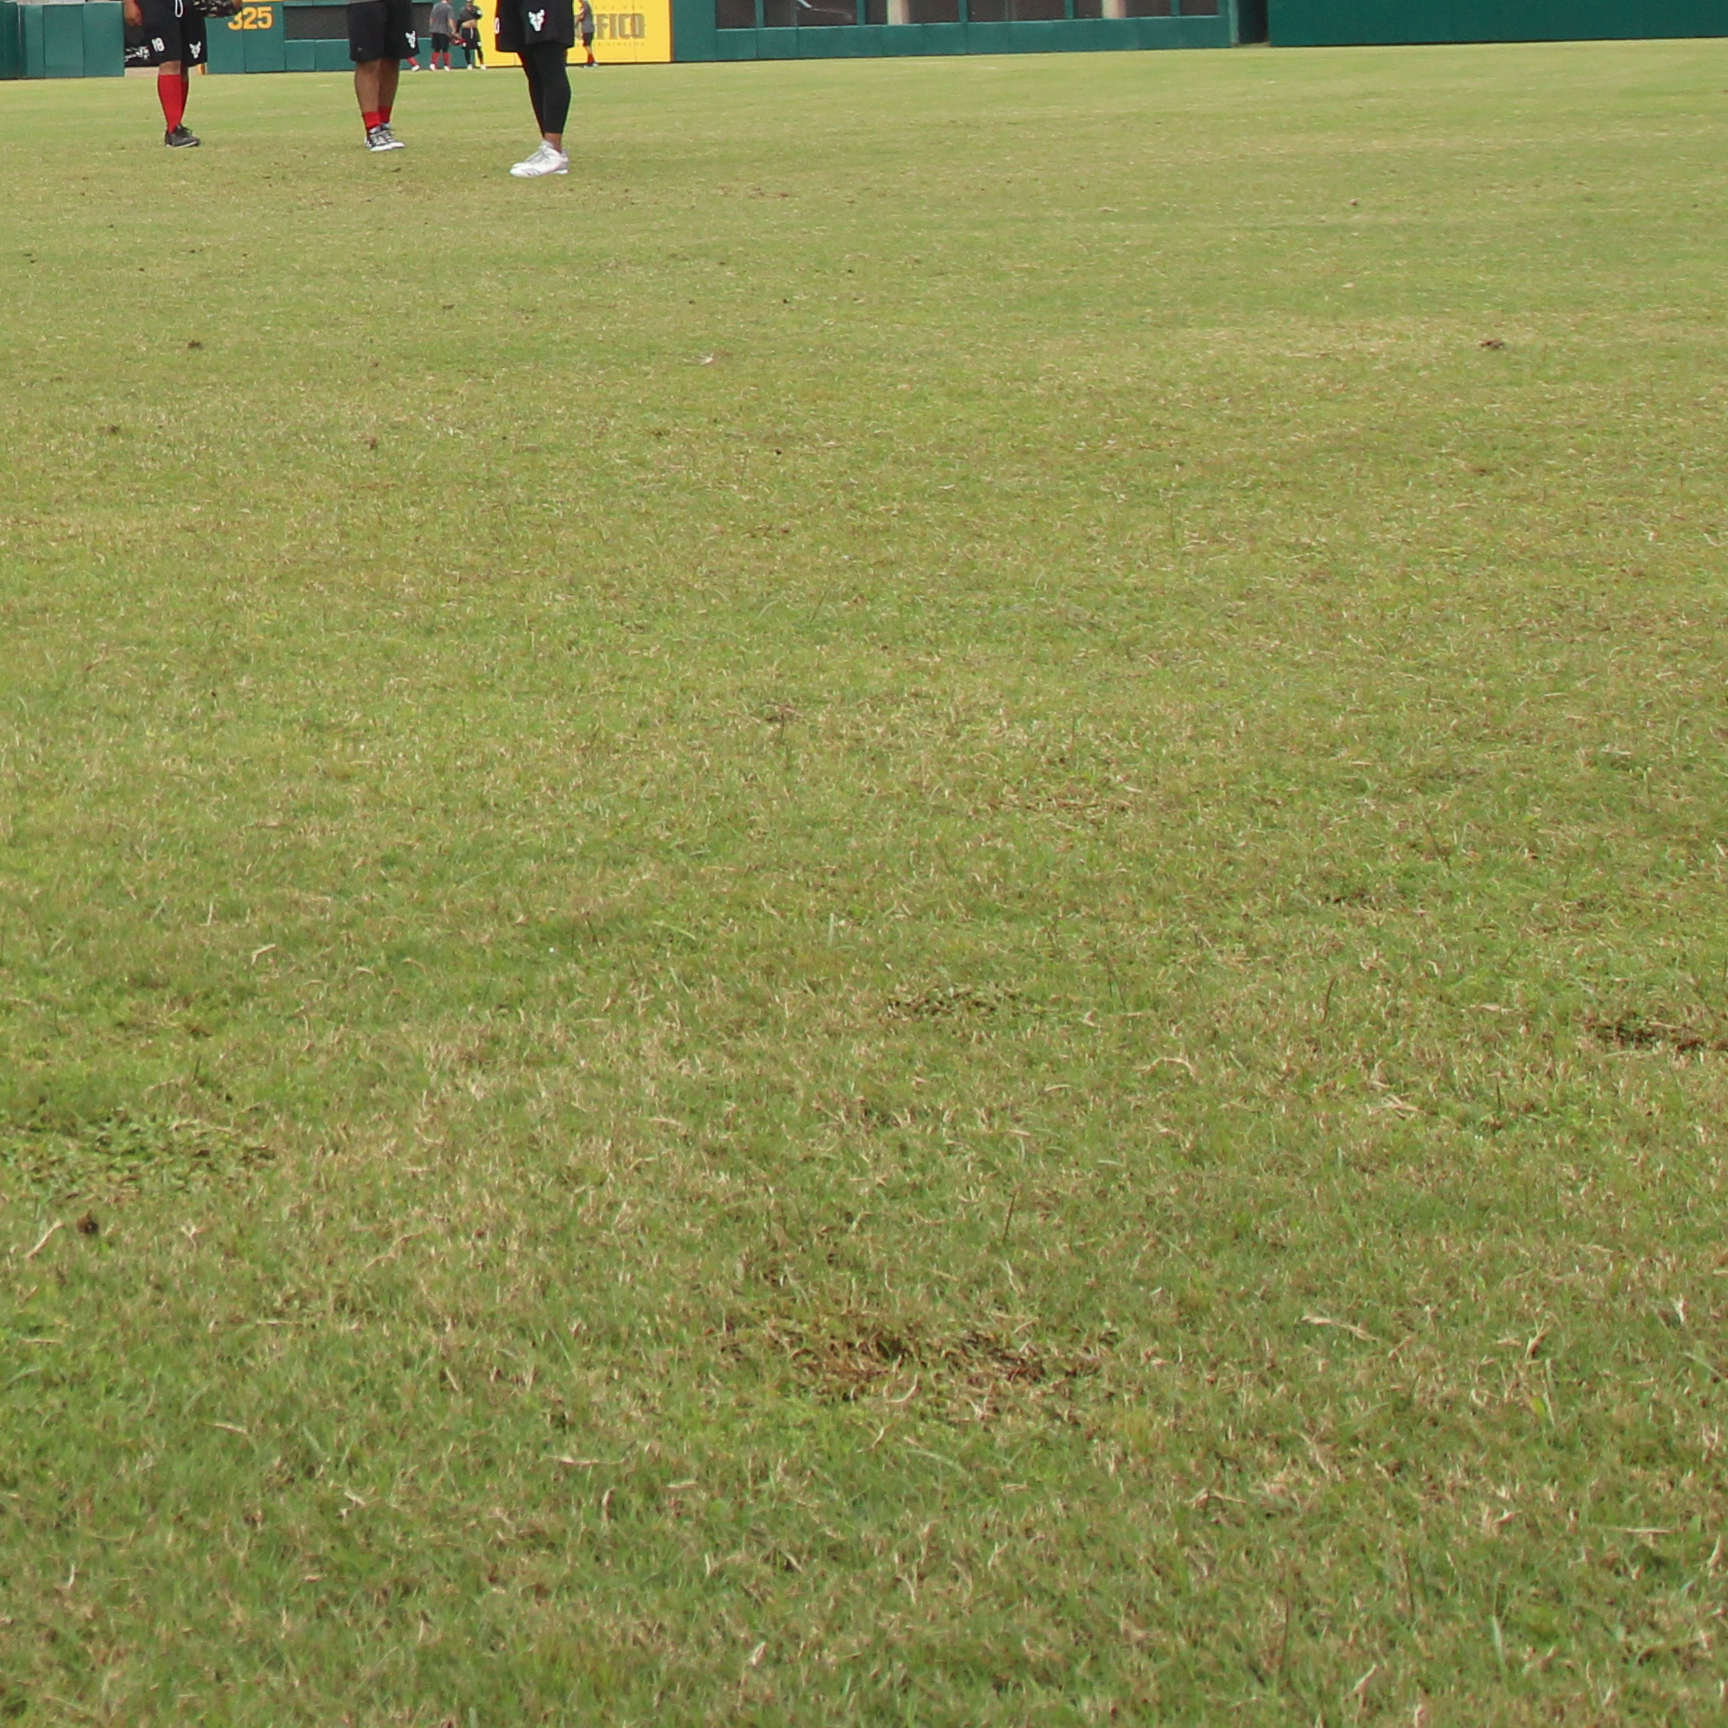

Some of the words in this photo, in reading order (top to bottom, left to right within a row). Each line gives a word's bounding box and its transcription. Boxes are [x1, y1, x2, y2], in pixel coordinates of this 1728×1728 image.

[228, 6, 273, 30] 325
[594, 13, 646, 40] FICO
[151, 37, 165, 53] 18
